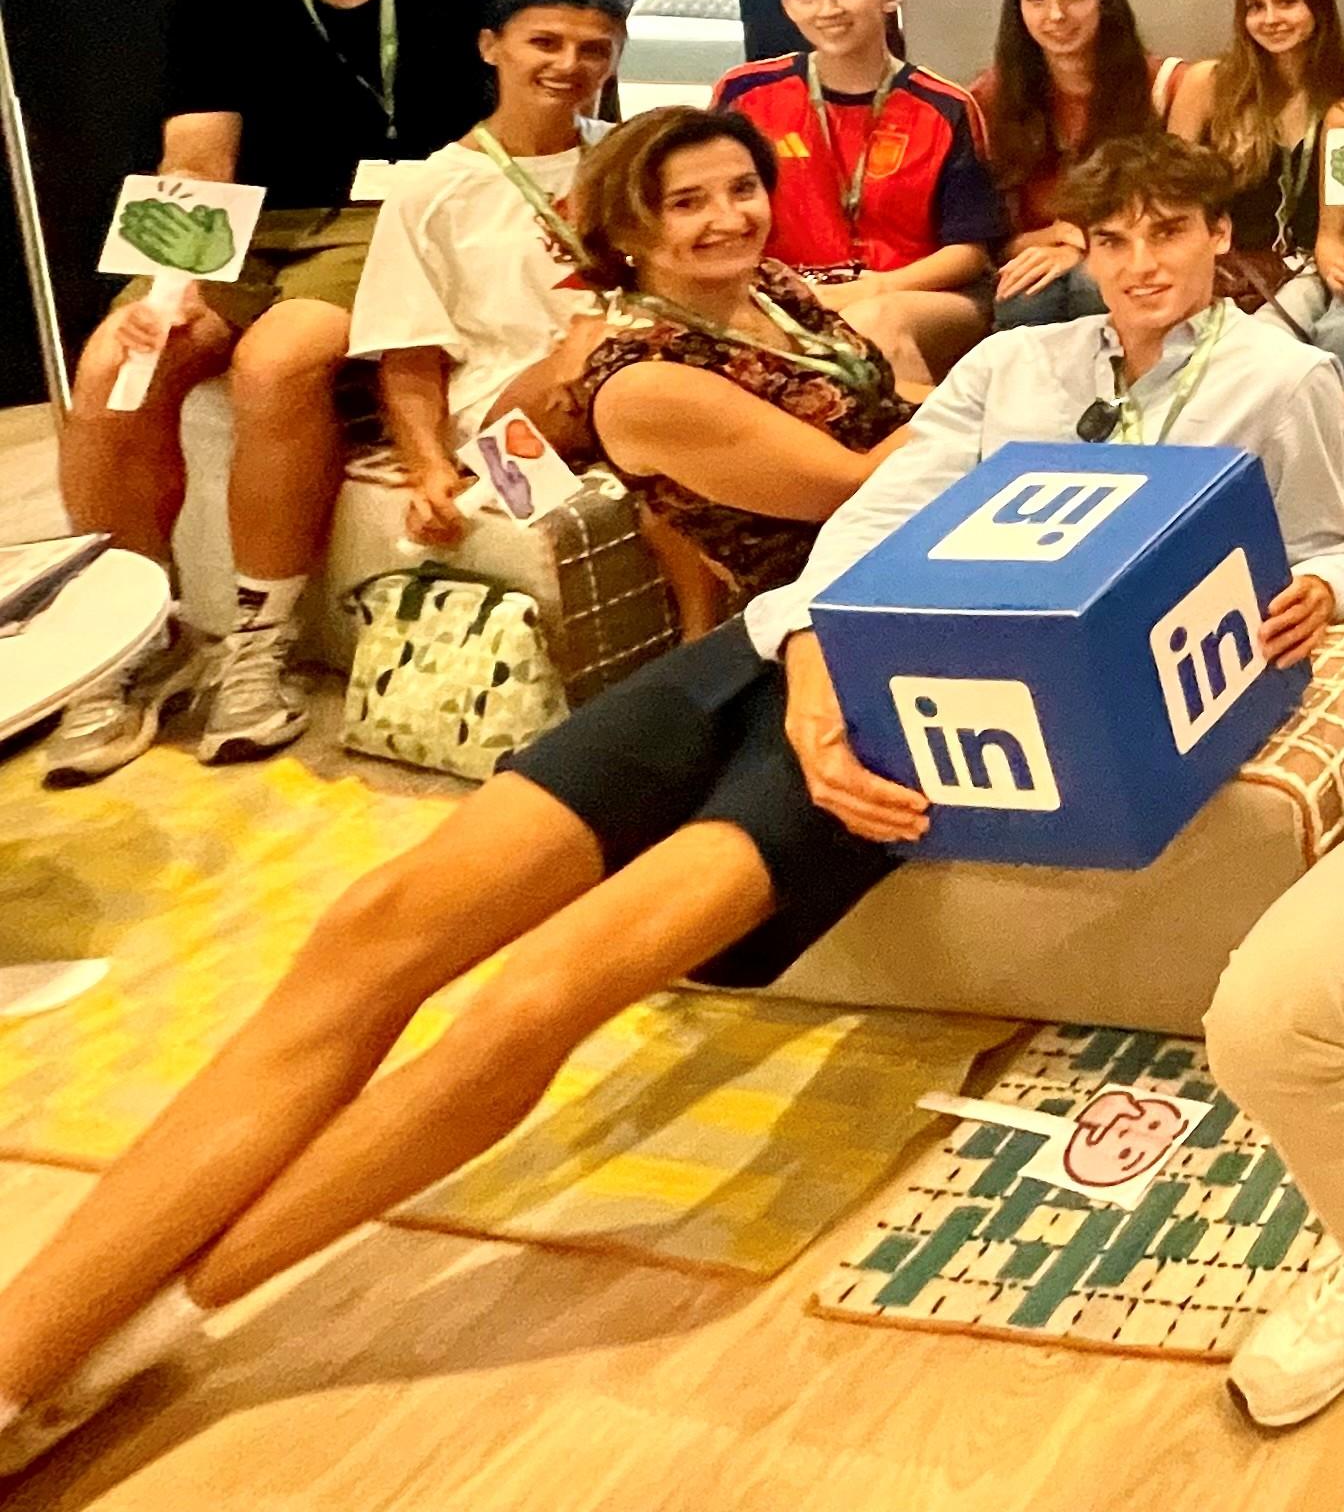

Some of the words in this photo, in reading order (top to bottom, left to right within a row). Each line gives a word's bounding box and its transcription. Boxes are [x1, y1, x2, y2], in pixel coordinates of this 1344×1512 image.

[991, 485, 1116, 546] in
[1170, 609, 1254, 724] in
[915, 695, 1035, 792] in
